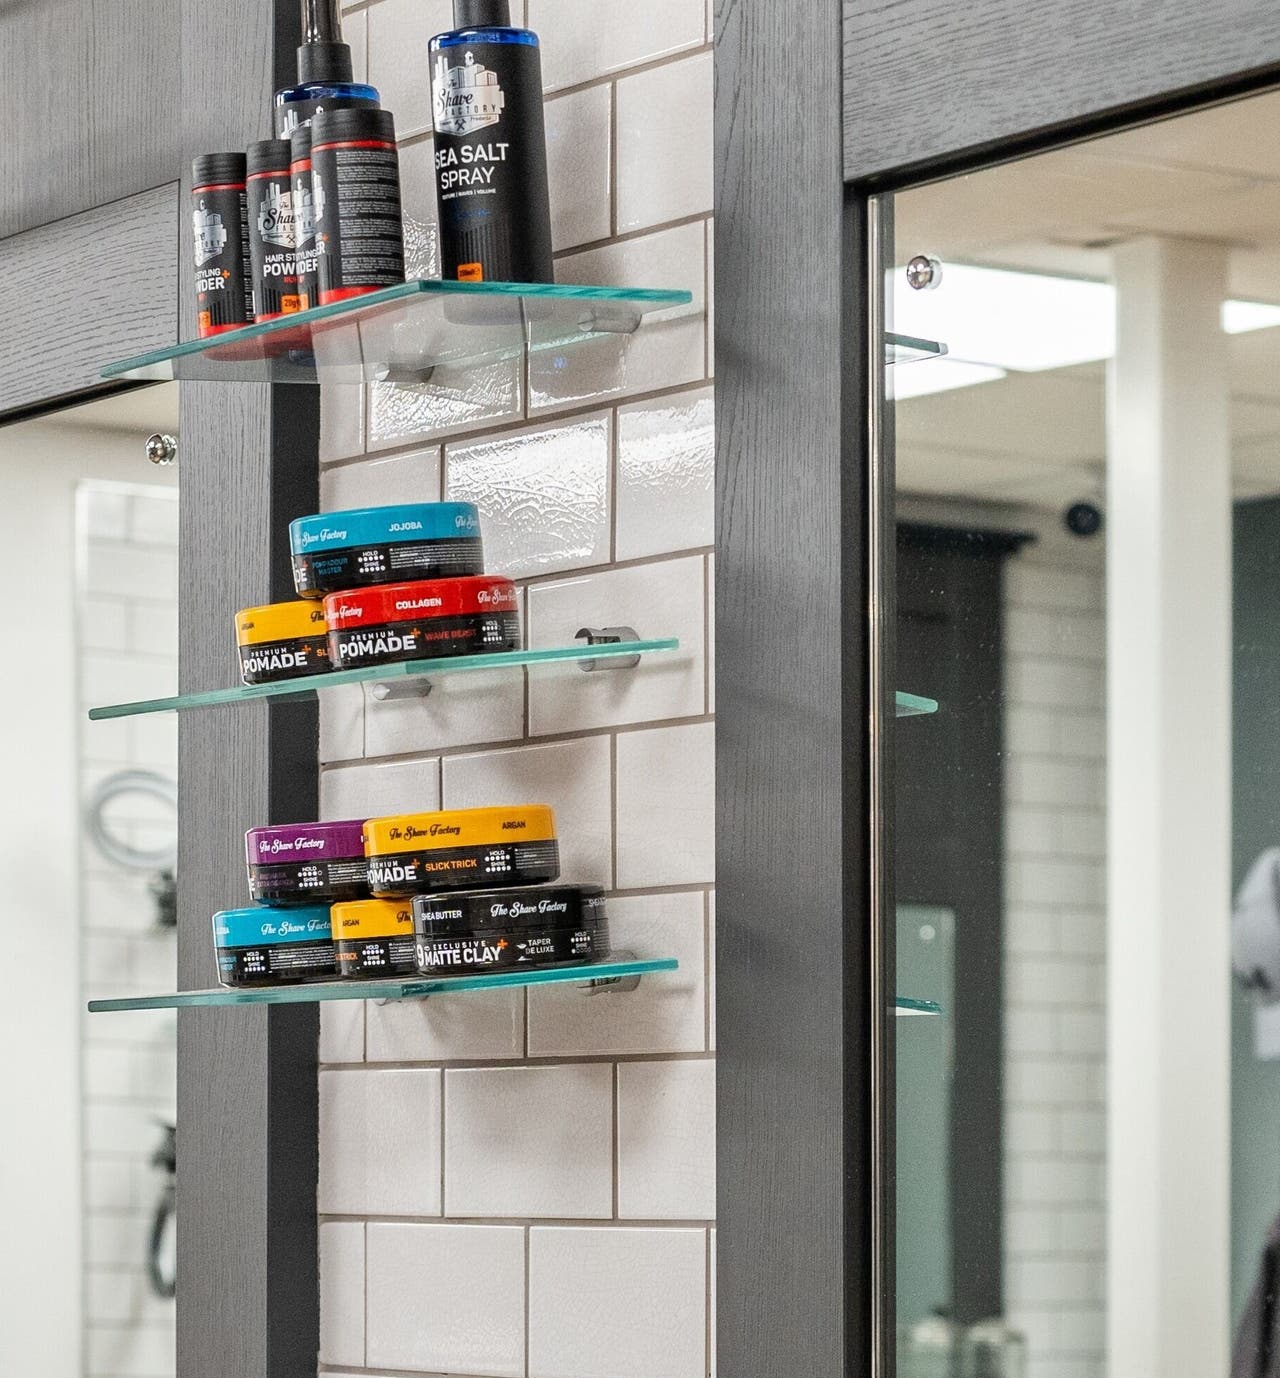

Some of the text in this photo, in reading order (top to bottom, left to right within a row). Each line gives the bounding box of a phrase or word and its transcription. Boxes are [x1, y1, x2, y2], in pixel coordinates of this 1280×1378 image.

[435, 143, 509, 170] SEA SALT
[441, 165, 495, 190] SPRAY
[265, 252, 286, 264] HAIR
[263, 260, 296, 277] POW
[389, 520, 423, 533] JOJOBA
[320, 527, 347, 542] Factory
[363, 550, 378, 558] HOLD
[396, 597, 442, 610] COLLAGEN
[351, 630, 395, 642] PREMIUM
[251, 648, 288, 658] PREMIUM
[339, 634, 417, 660] POMADE
[243, 651, 308, 674] POMADE
[389, 823, 461, 841] The Shave Factory
[502, 820, 526, 830] ARGAN
[259, 837, 325, 854] The Shave Factory
[425, 859, 477, 872] SLICK TRICK
[421, 909, 462, 921] SHEA BUTTER
[490, 900, 568, 918] The Shave Factory
[260, 923, 277, 937] The
[278, 921, 305, 936] Shave
[433, 940, 487, 950] EXCLUSIVE
[528, 938, 552, 947] TAPER
[425, 949, 461, 966] MATTE
[463, 946, 502, 964] CLAY
